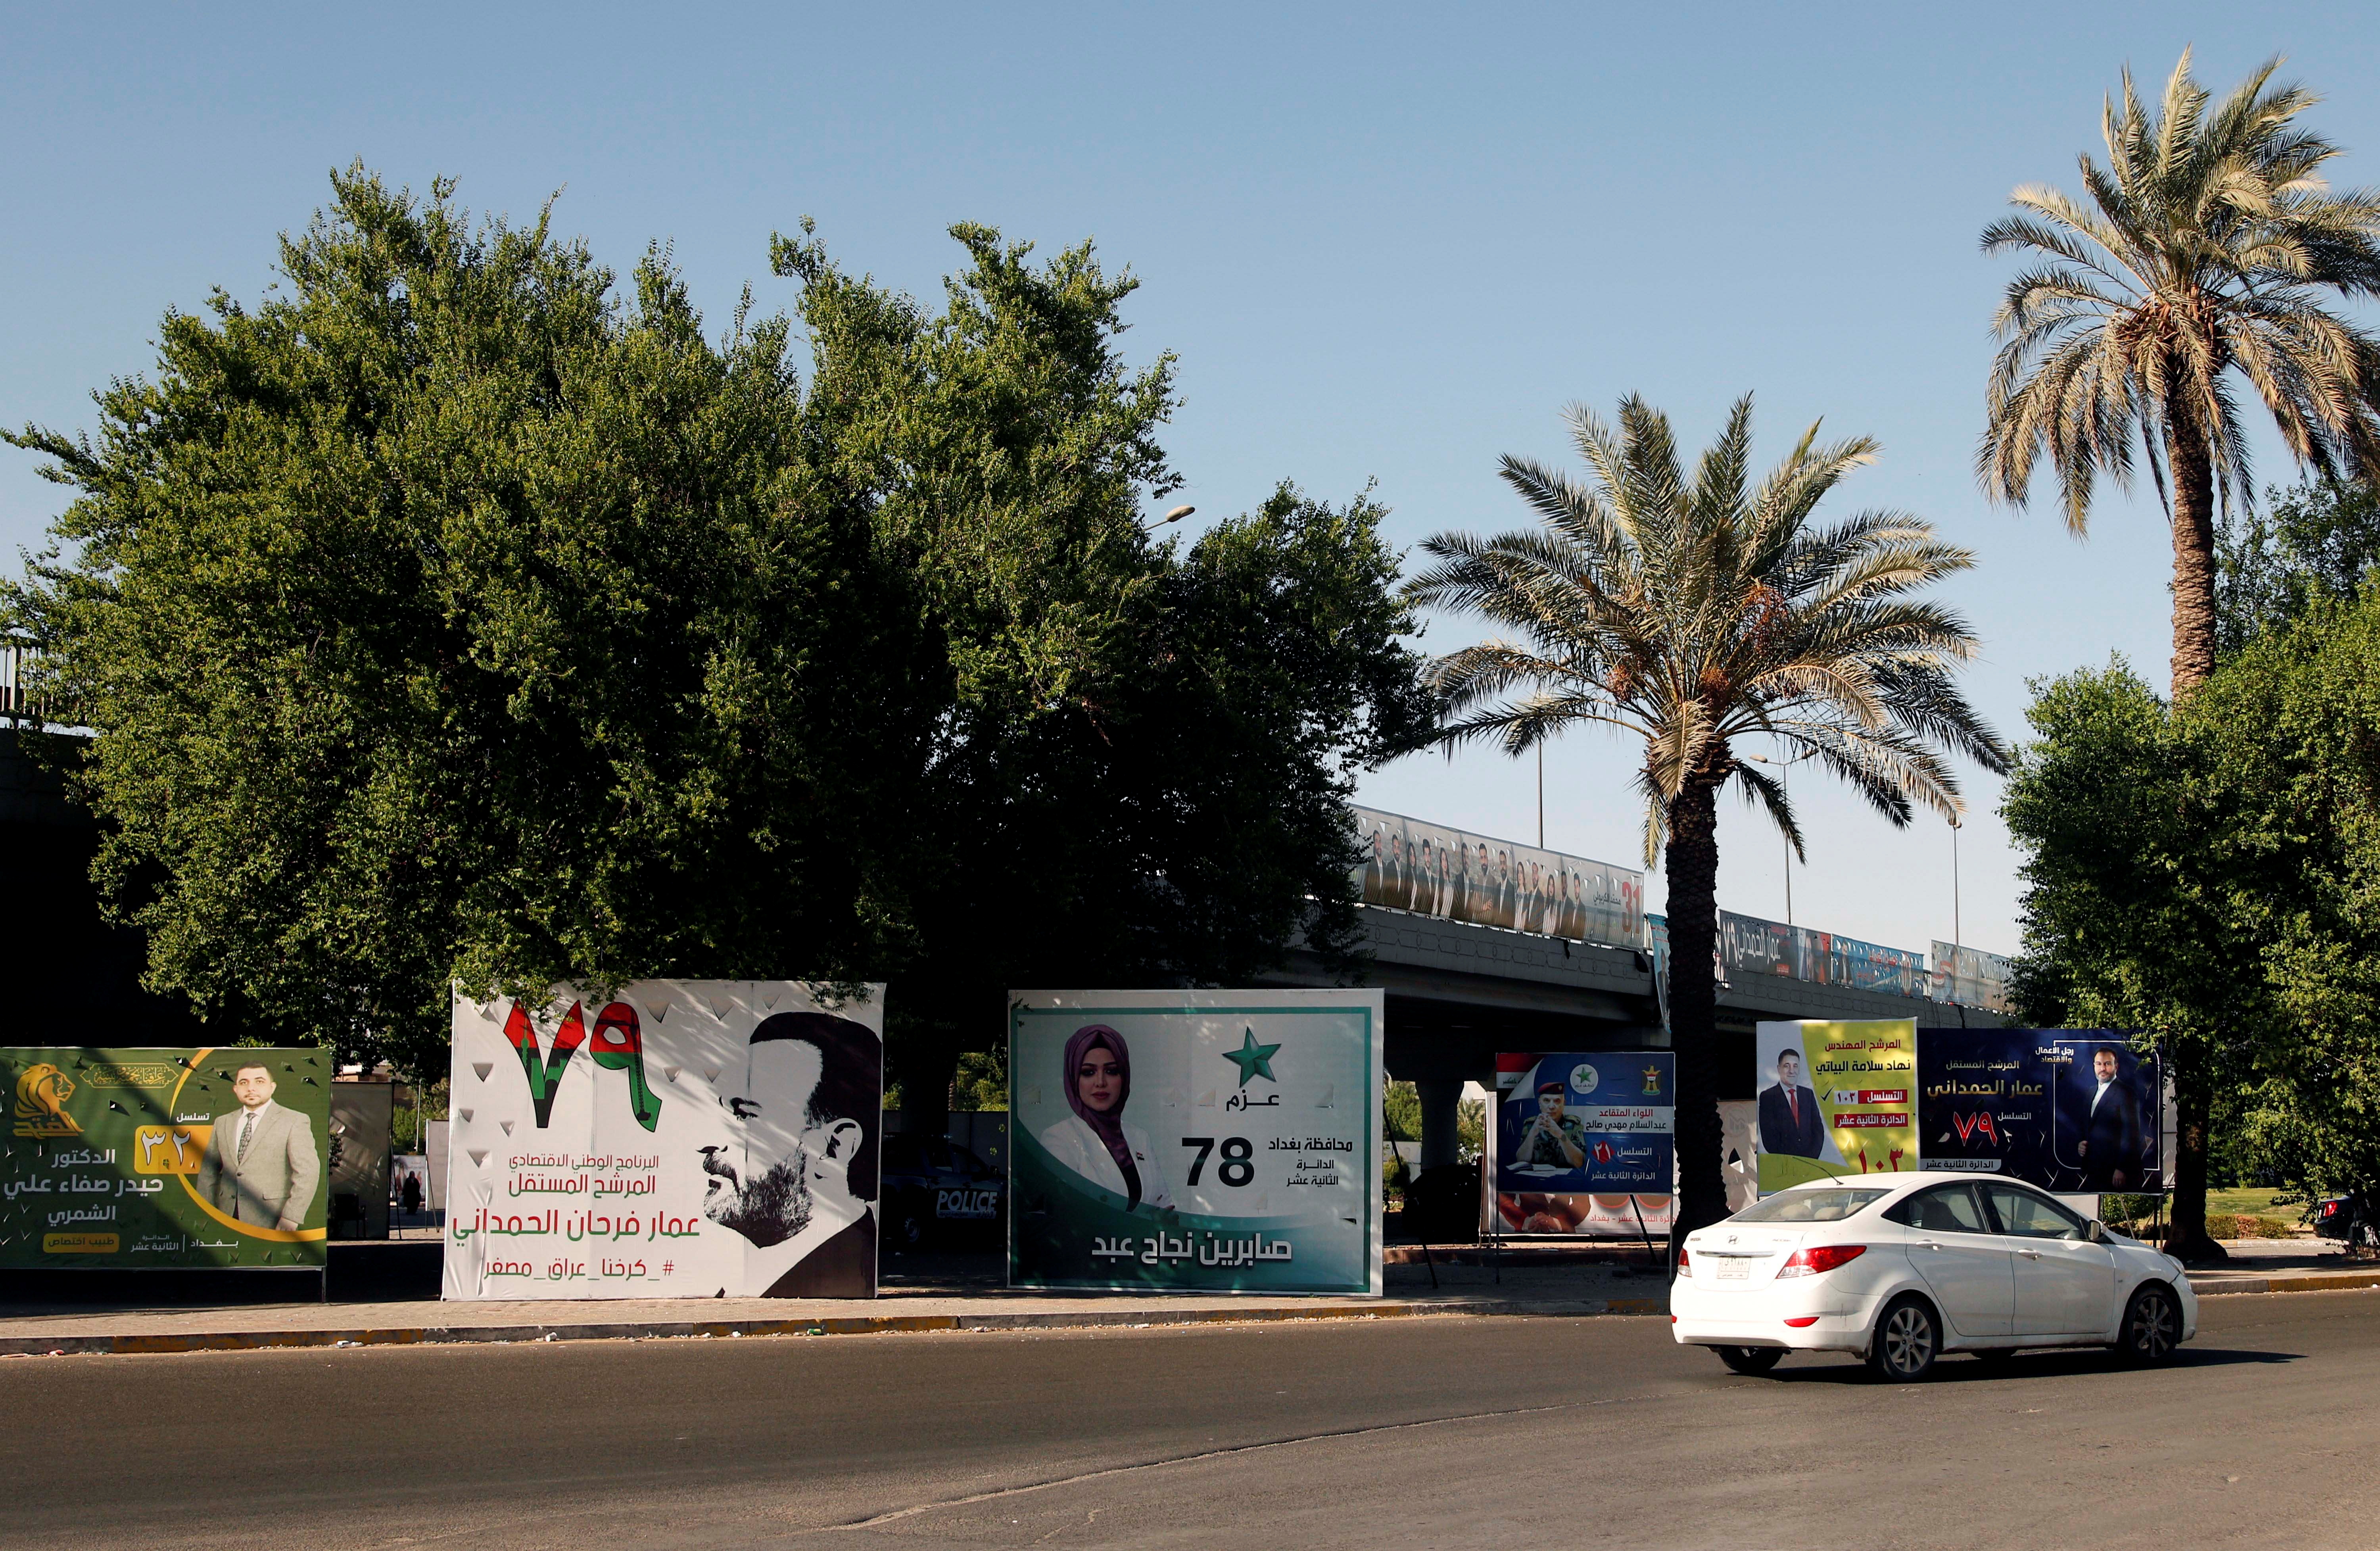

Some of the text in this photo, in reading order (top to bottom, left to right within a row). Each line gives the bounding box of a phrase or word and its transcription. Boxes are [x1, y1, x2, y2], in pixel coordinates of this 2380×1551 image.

[1622, 881, 1641, 934] 31
[1723, 920, 1738, 964] ٧٩
[1737, 924, 1781, 968] عمار الحمداني
[1825, 1038, 1900, 1052] المرشح المهندس
[2035, 1047, 2074, 1056] رجل الاعمال
[503, 999, 662, 1132] ٧٩
[1816, 1059, 1911, 1075] نهاد سلامة البياتي
[1945, 1059, 2019, 1072] المرشح المستقل
[2041, 1055, 2072, 1064] والاقتصاد
[1837, 1091, 1902, 1103] التسلسل ١٠٣
[1927, 1079, 2043, 1099] عمار الحمداني
[1226, 1089, 1280, 1111] عزم
[176, 1112, 210, 1122] تسلسل
[1599, 1108, 1653, 1119] اللواء المتقاعد
[1838, 1114, 1905, 1128] الدائرة الثانية عشر
[1998, 1111, 2031, 1122] التسلسل
[1586, 1120, 1603, 1131] صالح
[1605, 1122, 1627, 1132] مهدي
[1953, 1111, 1998, 1146] ٧٩
[141, 1130, 191, 1166] ٣٢
[1269, 1137, 1353, 1154] محافظة بغداد
[1594, 1143, 1652, 1160] التسلسل ٢١
[51, 1148, 116, 1168] الدكتور
[509, 1153, 659, 1174] البرنامج الوطني الاقتصادي
[1182, 1136, 1255, 1188] 78
[1296, 1159, 1334, 1171] الدائرة
[1858, 1148, 1903, 1174] ١٠٣
[1925, 1159, 1994, 1170] الدائرة الثانية عشر
[1286, 1173, 1339, 1188] الثانية عشر
[1591, 1170, 1655, 1182] الدائرة الثانية عشر
[4, 1174, 164, 1200] حيدر صفاء علي
[509, 1172, 656, 1199] المرشح المستقل
[936, 1190, 998, 1211] POLICE
[48, 1203, 116, 1227] الشمري
[1590, 1214, 1610, 1223] بغداد
[1618, 1213, 1633, 1223] عشر
[452, 1207, 701, 1247] عمار فرحان الحمداني
[48, 1237, 114, 1247] طبيب اختصاص
[130, 1241, 178, 1253] الثانية عشر
[190, 1239, 239, 1249] بغداد
[1091, 1230, 1292, 1266] صابرين نجاح عبد
